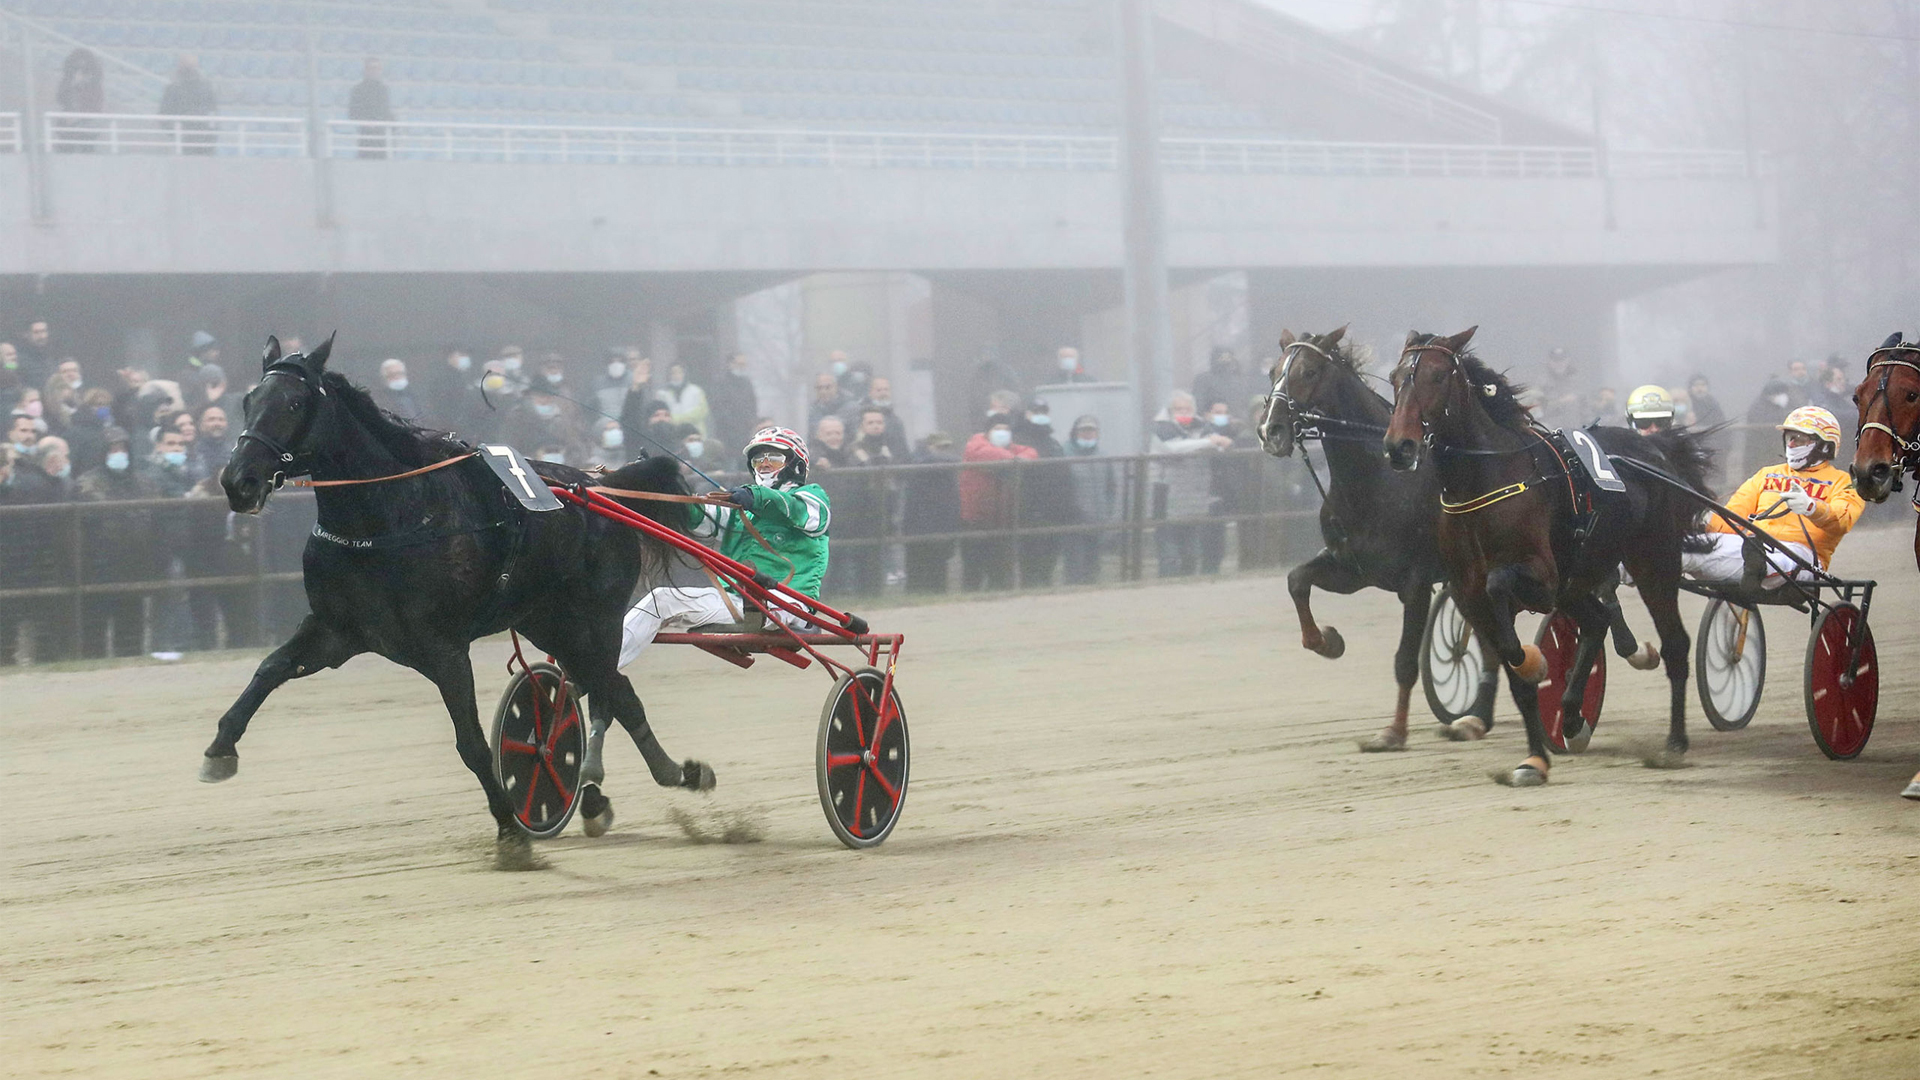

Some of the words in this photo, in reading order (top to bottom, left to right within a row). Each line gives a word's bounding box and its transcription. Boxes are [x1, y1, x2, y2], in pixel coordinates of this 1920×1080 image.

[485, 445, 537, 499] 7
[1572, 430, 1616, 480] 2
[317, 528, 349, 546] BAREGGIO
[352, 540, 373, 548] TEAM
